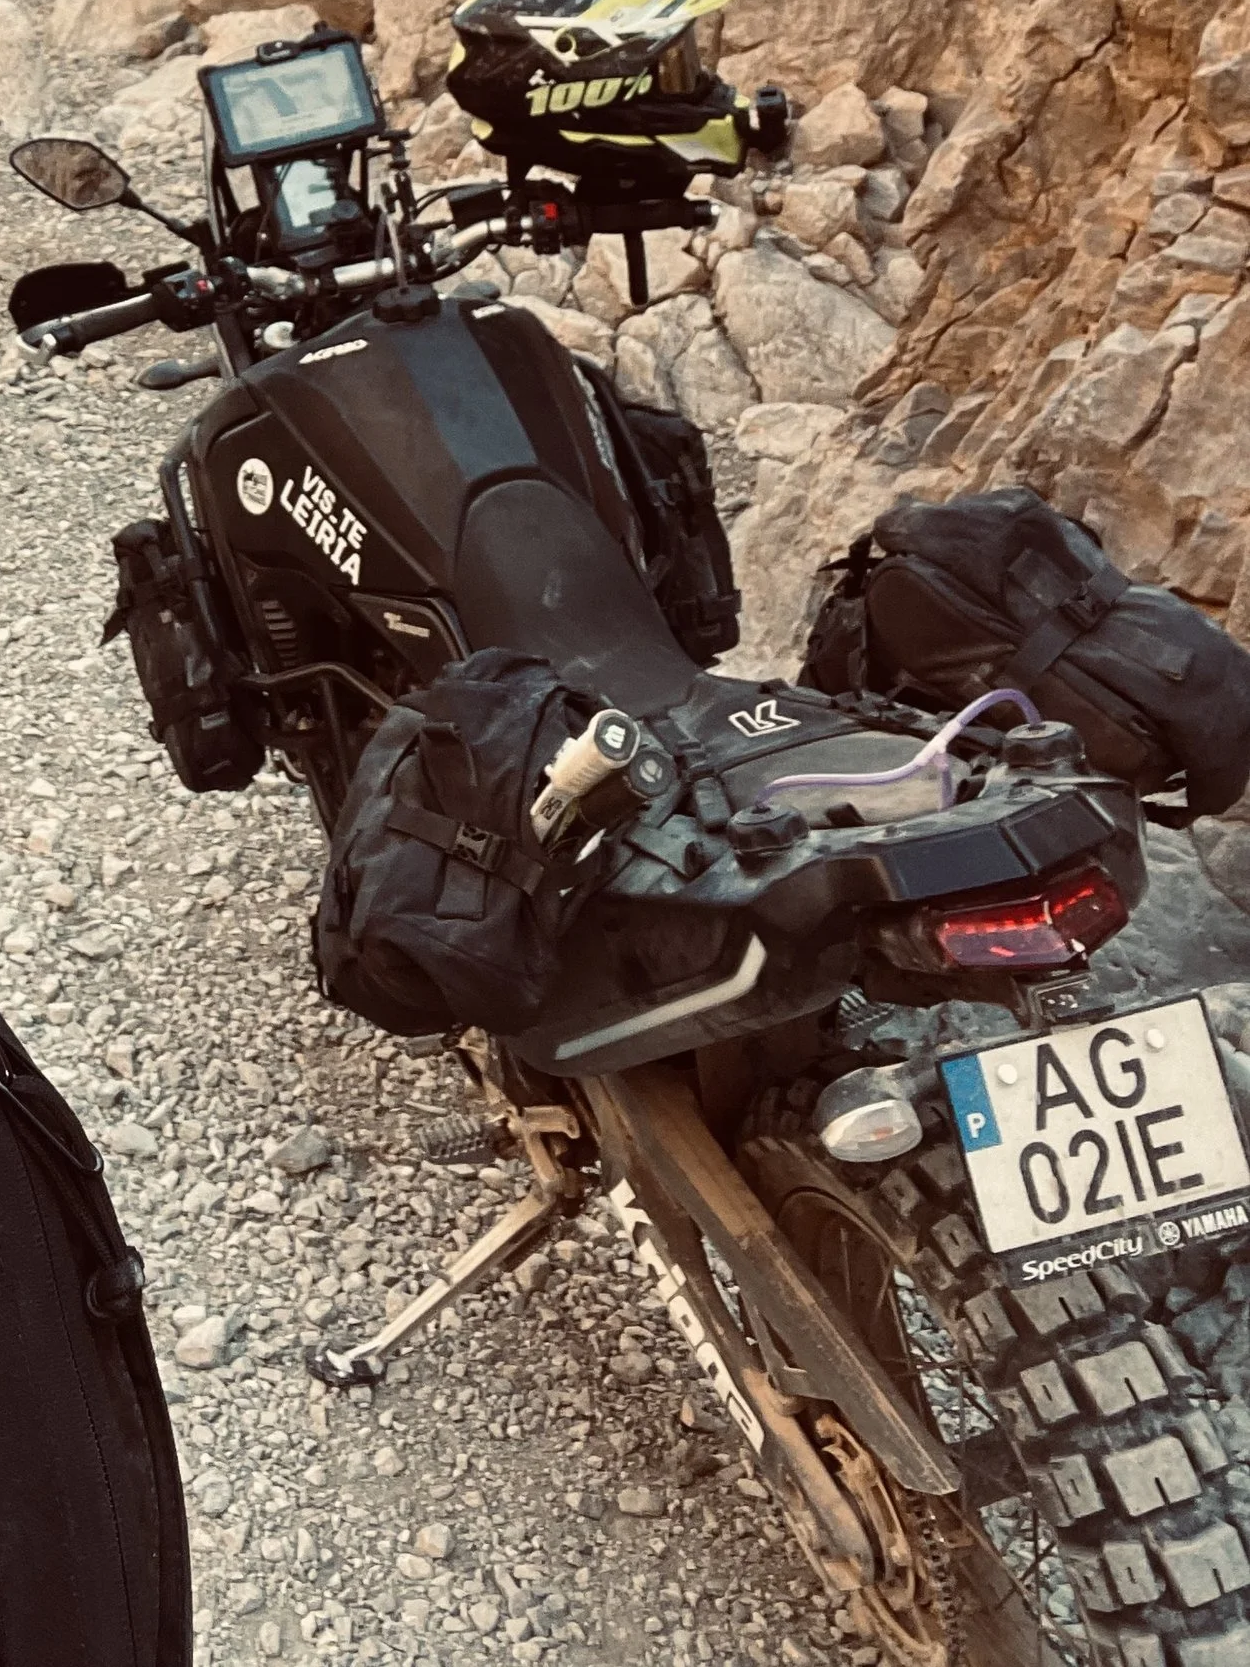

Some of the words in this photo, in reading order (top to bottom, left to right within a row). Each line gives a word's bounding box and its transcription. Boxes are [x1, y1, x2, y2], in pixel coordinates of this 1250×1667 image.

[525, 66, 653, 116] 100%
[279, 478, 361, 586] LEIRIA
[1036, 1027, 1147, 1131] AG
[966, 1112, 986, 1139] P
[1181, 1205, 1249, 1239] YAMAHA
[1021, 1234, 1143, 1281] SpeedCity
